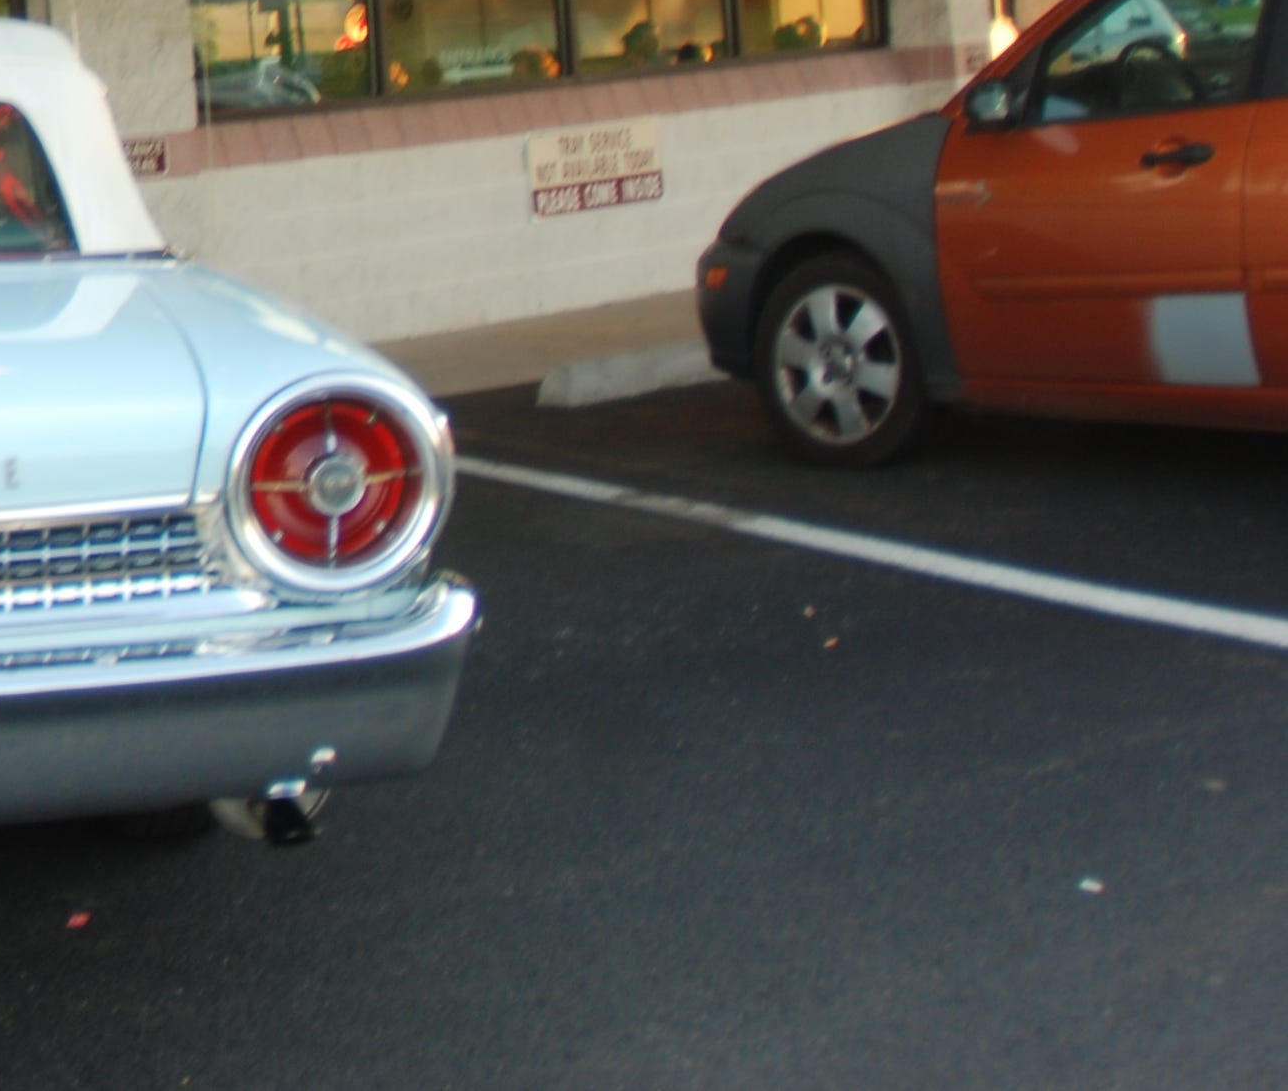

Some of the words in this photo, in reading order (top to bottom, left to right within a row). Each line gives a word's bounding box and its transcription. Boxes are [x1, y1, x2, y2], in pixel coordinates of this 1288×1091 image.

[558, 133, 584, 156] TRAY
[590, 126, 632, 153] SERVICE
[536, 161, 556, 182] NOT
[561, 153, 620, 180] AVAILABLE
[622, 148, 655, 172] TODAY
[537, 185, 580, 216] PLEASE
[583, 179, 618, 208] COME
[622, 173, 662, 202] INSIDE
